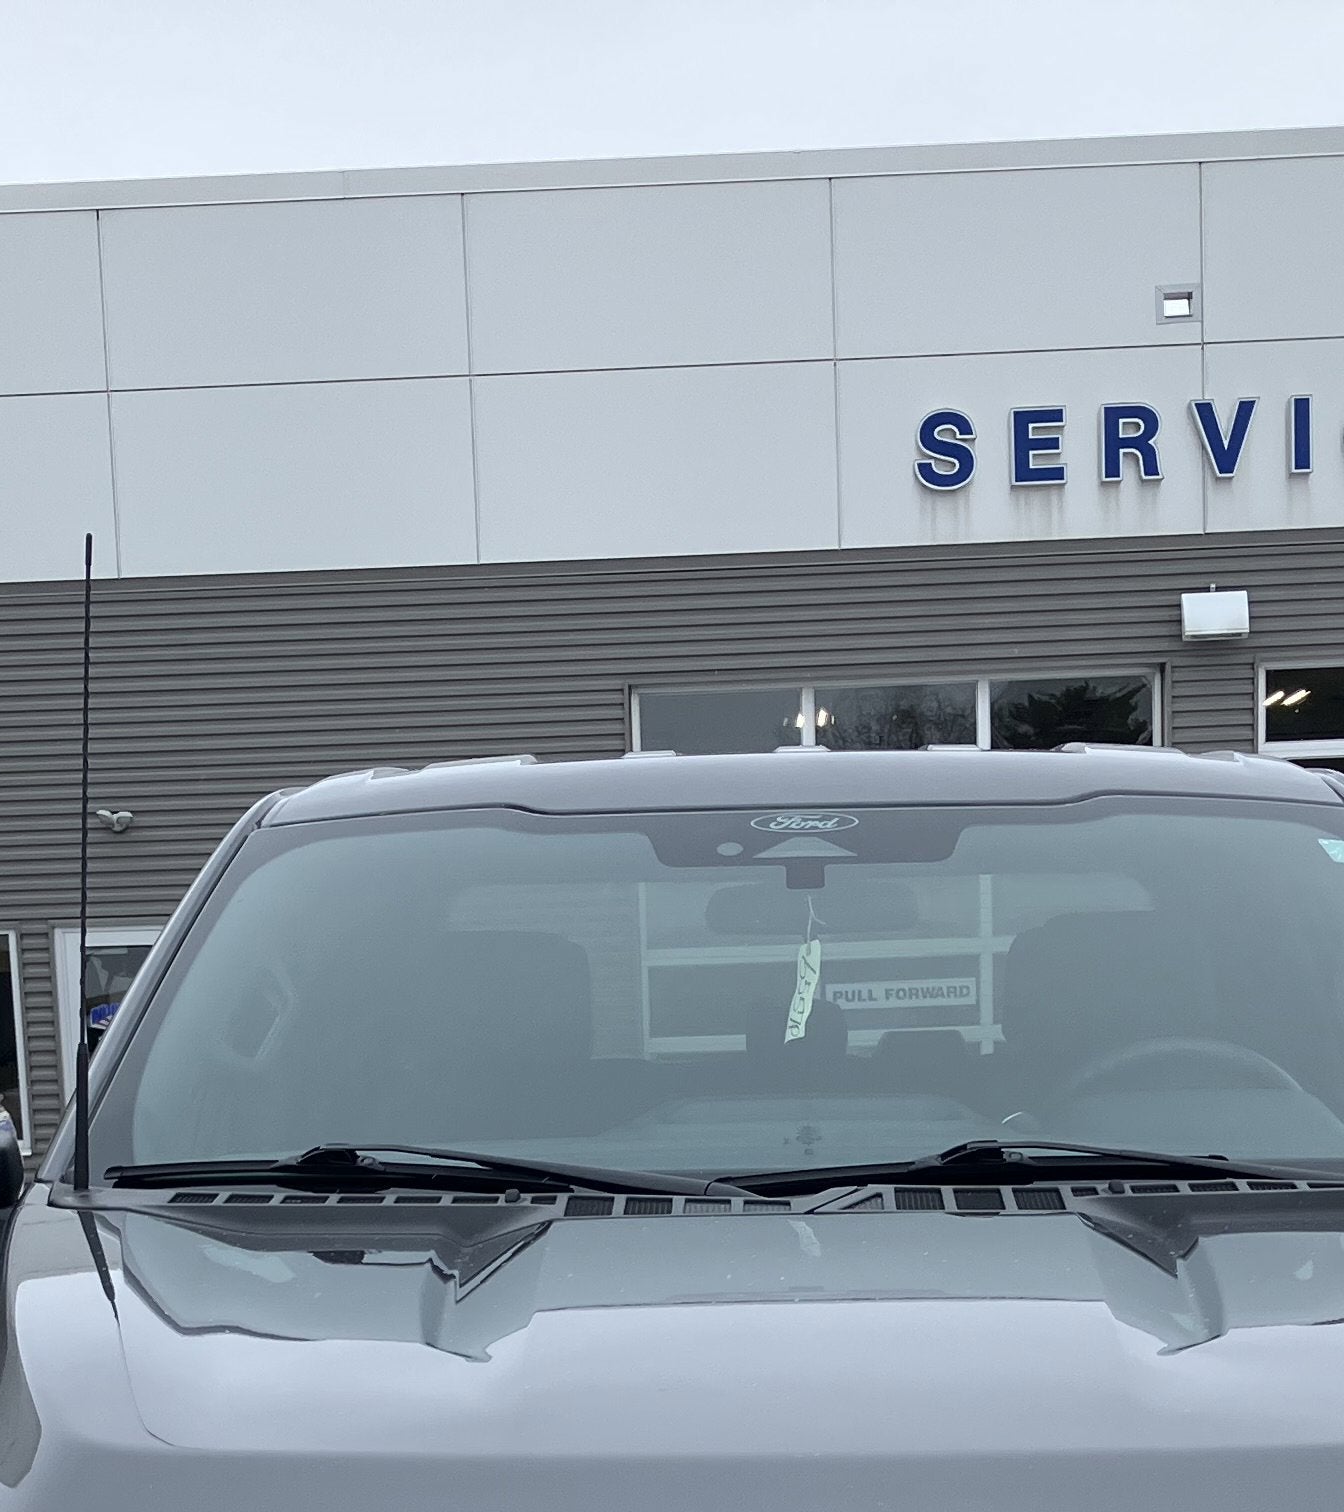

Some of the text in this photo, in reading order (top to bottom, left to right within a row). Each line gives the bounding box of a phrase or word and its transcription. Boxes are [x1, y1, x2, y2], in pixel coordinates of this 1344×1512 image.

[769, 814, 841, 830] Ford
[832, 985, 971, 1003] PULL FORWARD
